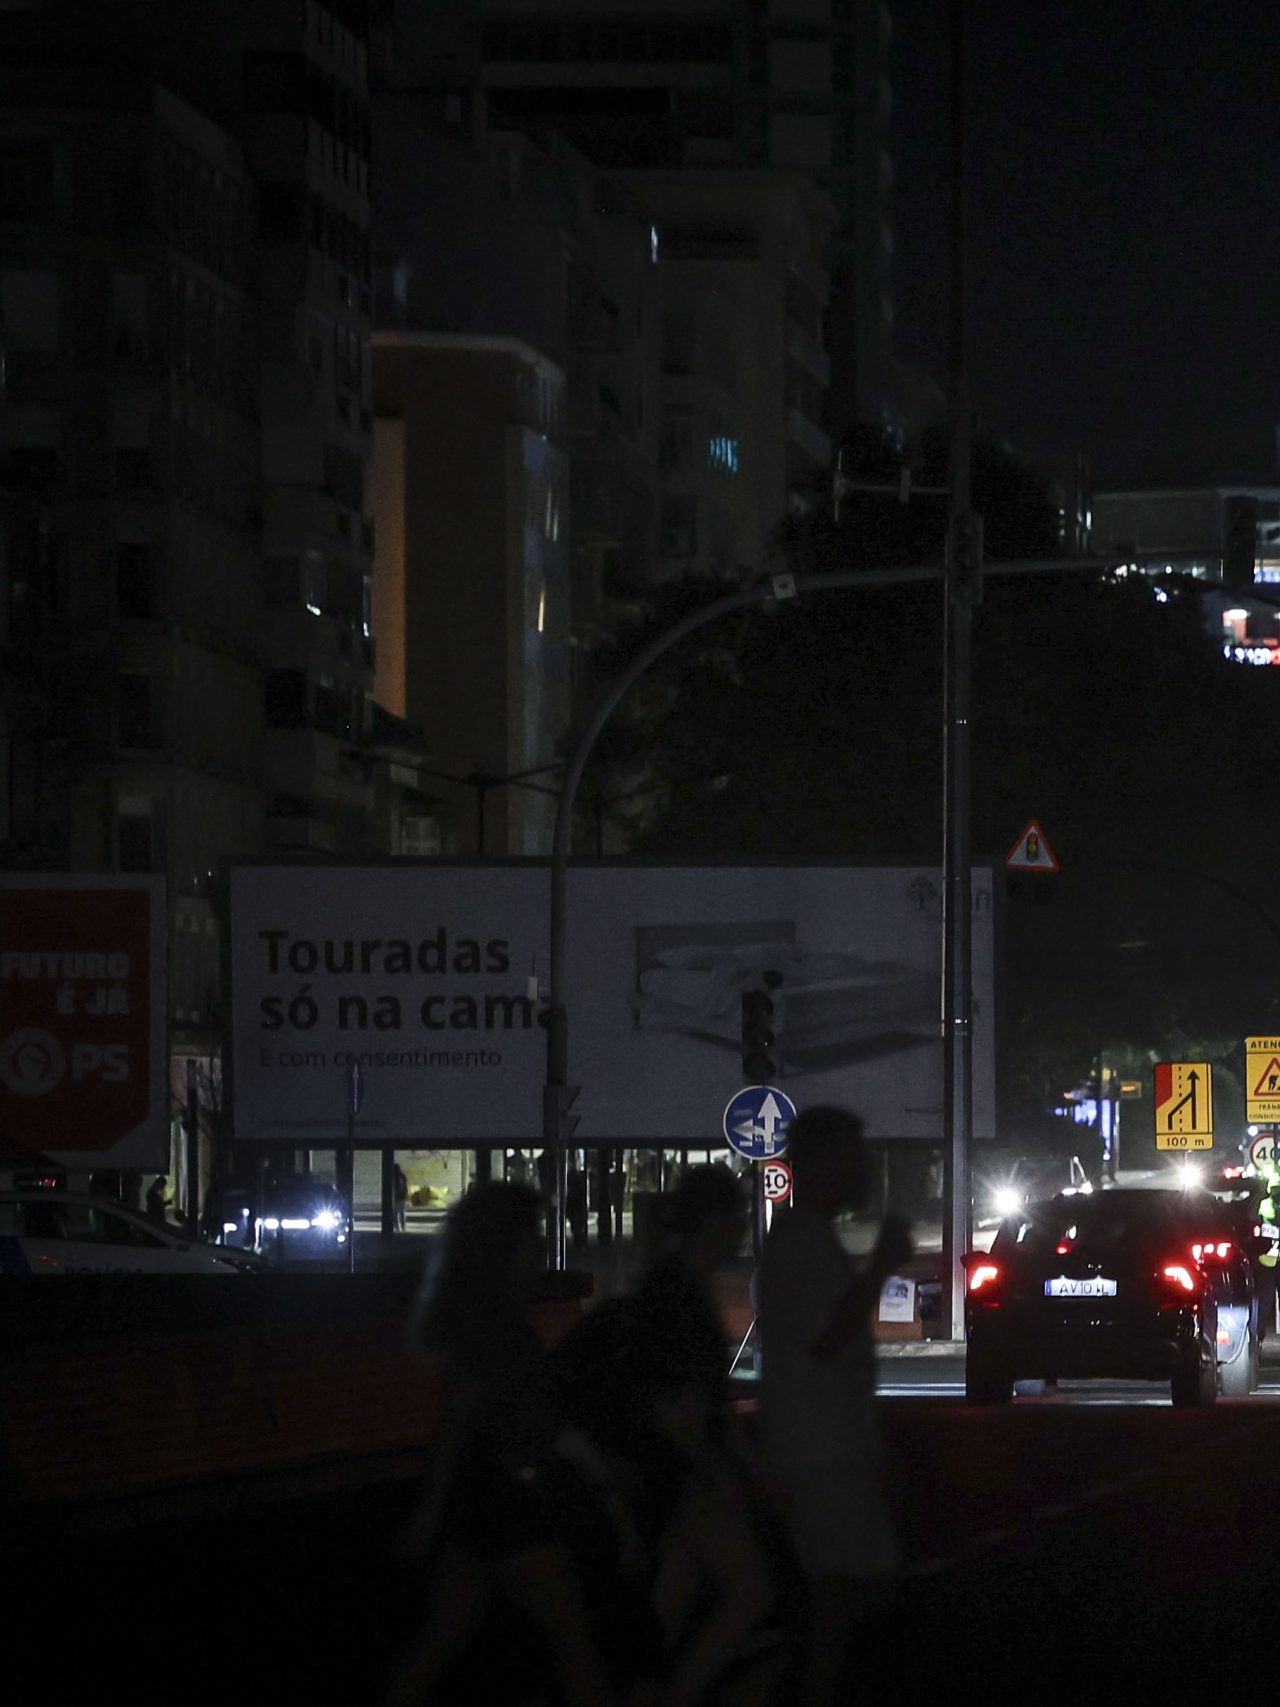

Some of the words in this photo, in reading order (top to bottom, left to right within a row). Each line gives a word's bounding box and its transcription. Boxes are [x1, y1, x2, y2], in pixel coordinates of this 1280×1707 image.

[1, 951, 130, 980] FUTURO
[257, 926, 510, 975] Touradas
[260, 983, 319, 1031] só
[337, 994, 402, 1031] na
[71, 1042, 130, 1082] PS
[259, 1049, 271, 1067] E
[279, 1051, 326, 1068] com
[334, 1048, 502, 1068] consentimento
[1166, 1137, 1188, 1147] 100
[1194, 1138, 1205, 1147] m
